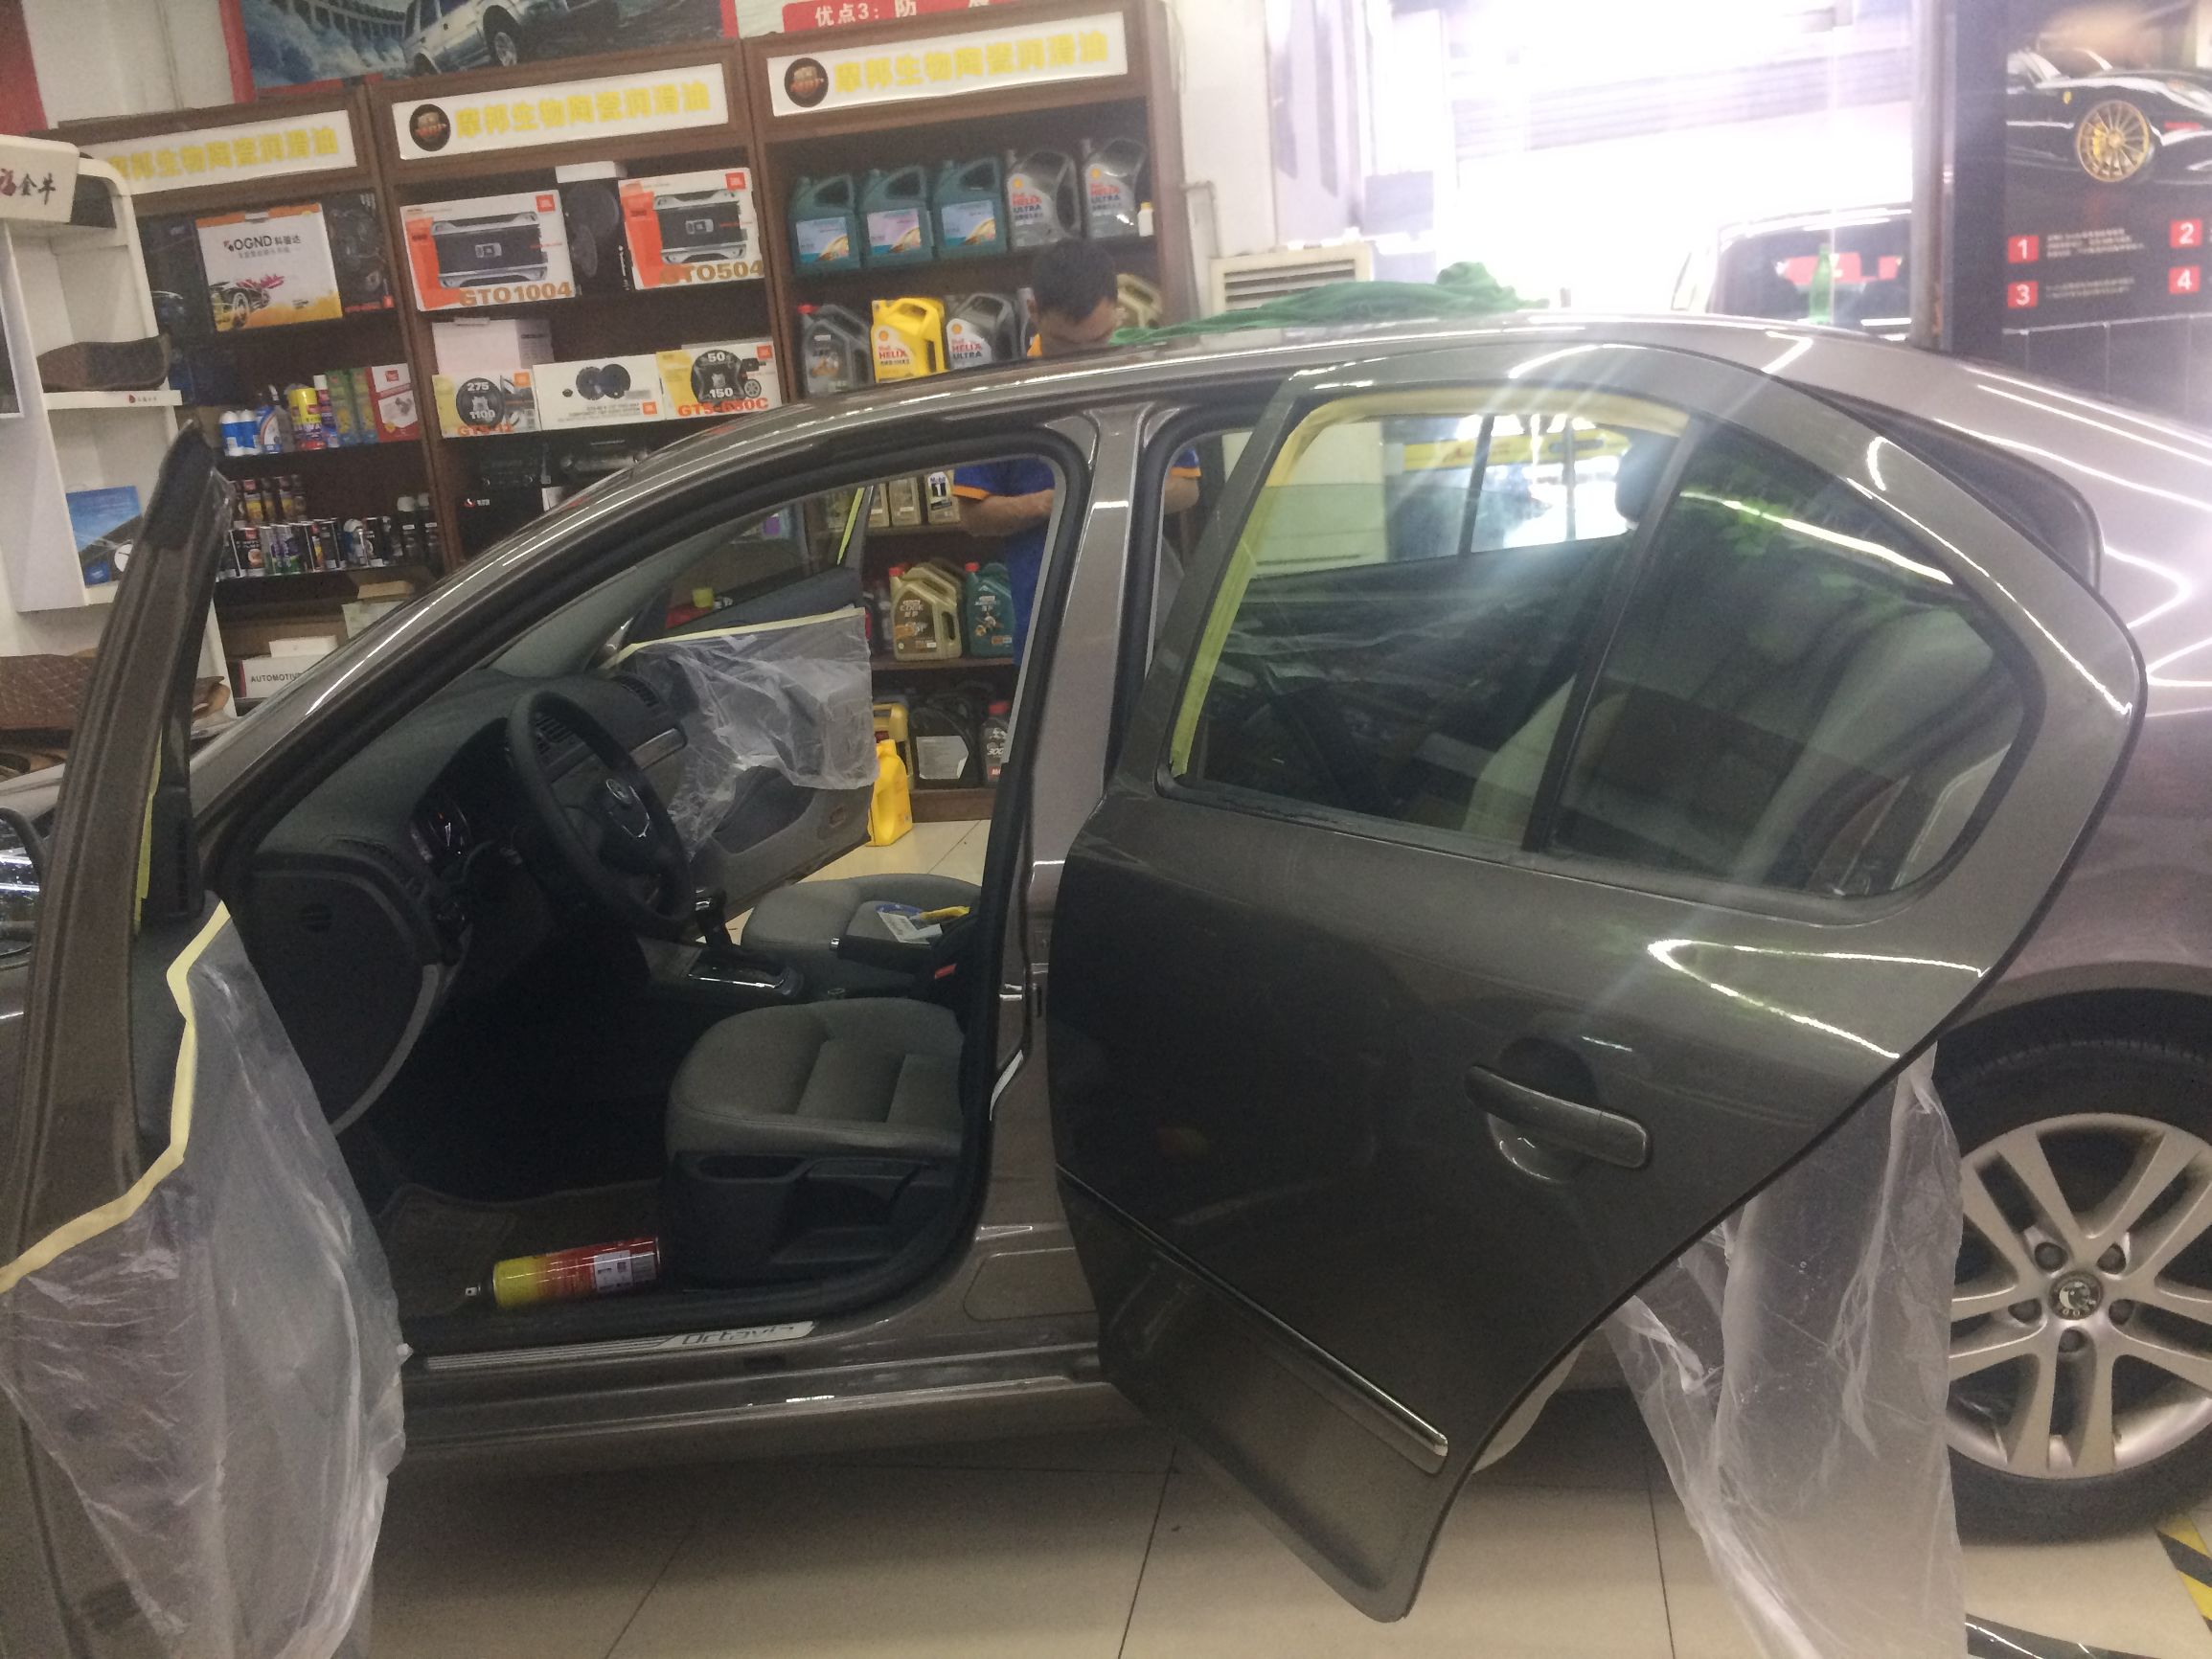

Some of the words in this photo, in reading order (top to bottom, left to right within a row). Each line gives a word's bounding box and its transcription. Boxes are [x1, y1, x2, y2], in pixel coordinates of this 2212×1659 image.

[2178, 222, 2194, 244] 2
[2018, 239, 2028, 260] 1
[2177, 269, 2192, 290] 4
[459, 282, 573, 307] GTO1004
[2016, 284, 2030, 306] 3
[707, 352, 726, 363] 50
[467, 381, 490, 392] 275
[709, 387, 734, 398] 150
[469, 409, 495, 420] 1100
[251, 672, 303, 683] AUTOMOTIV
